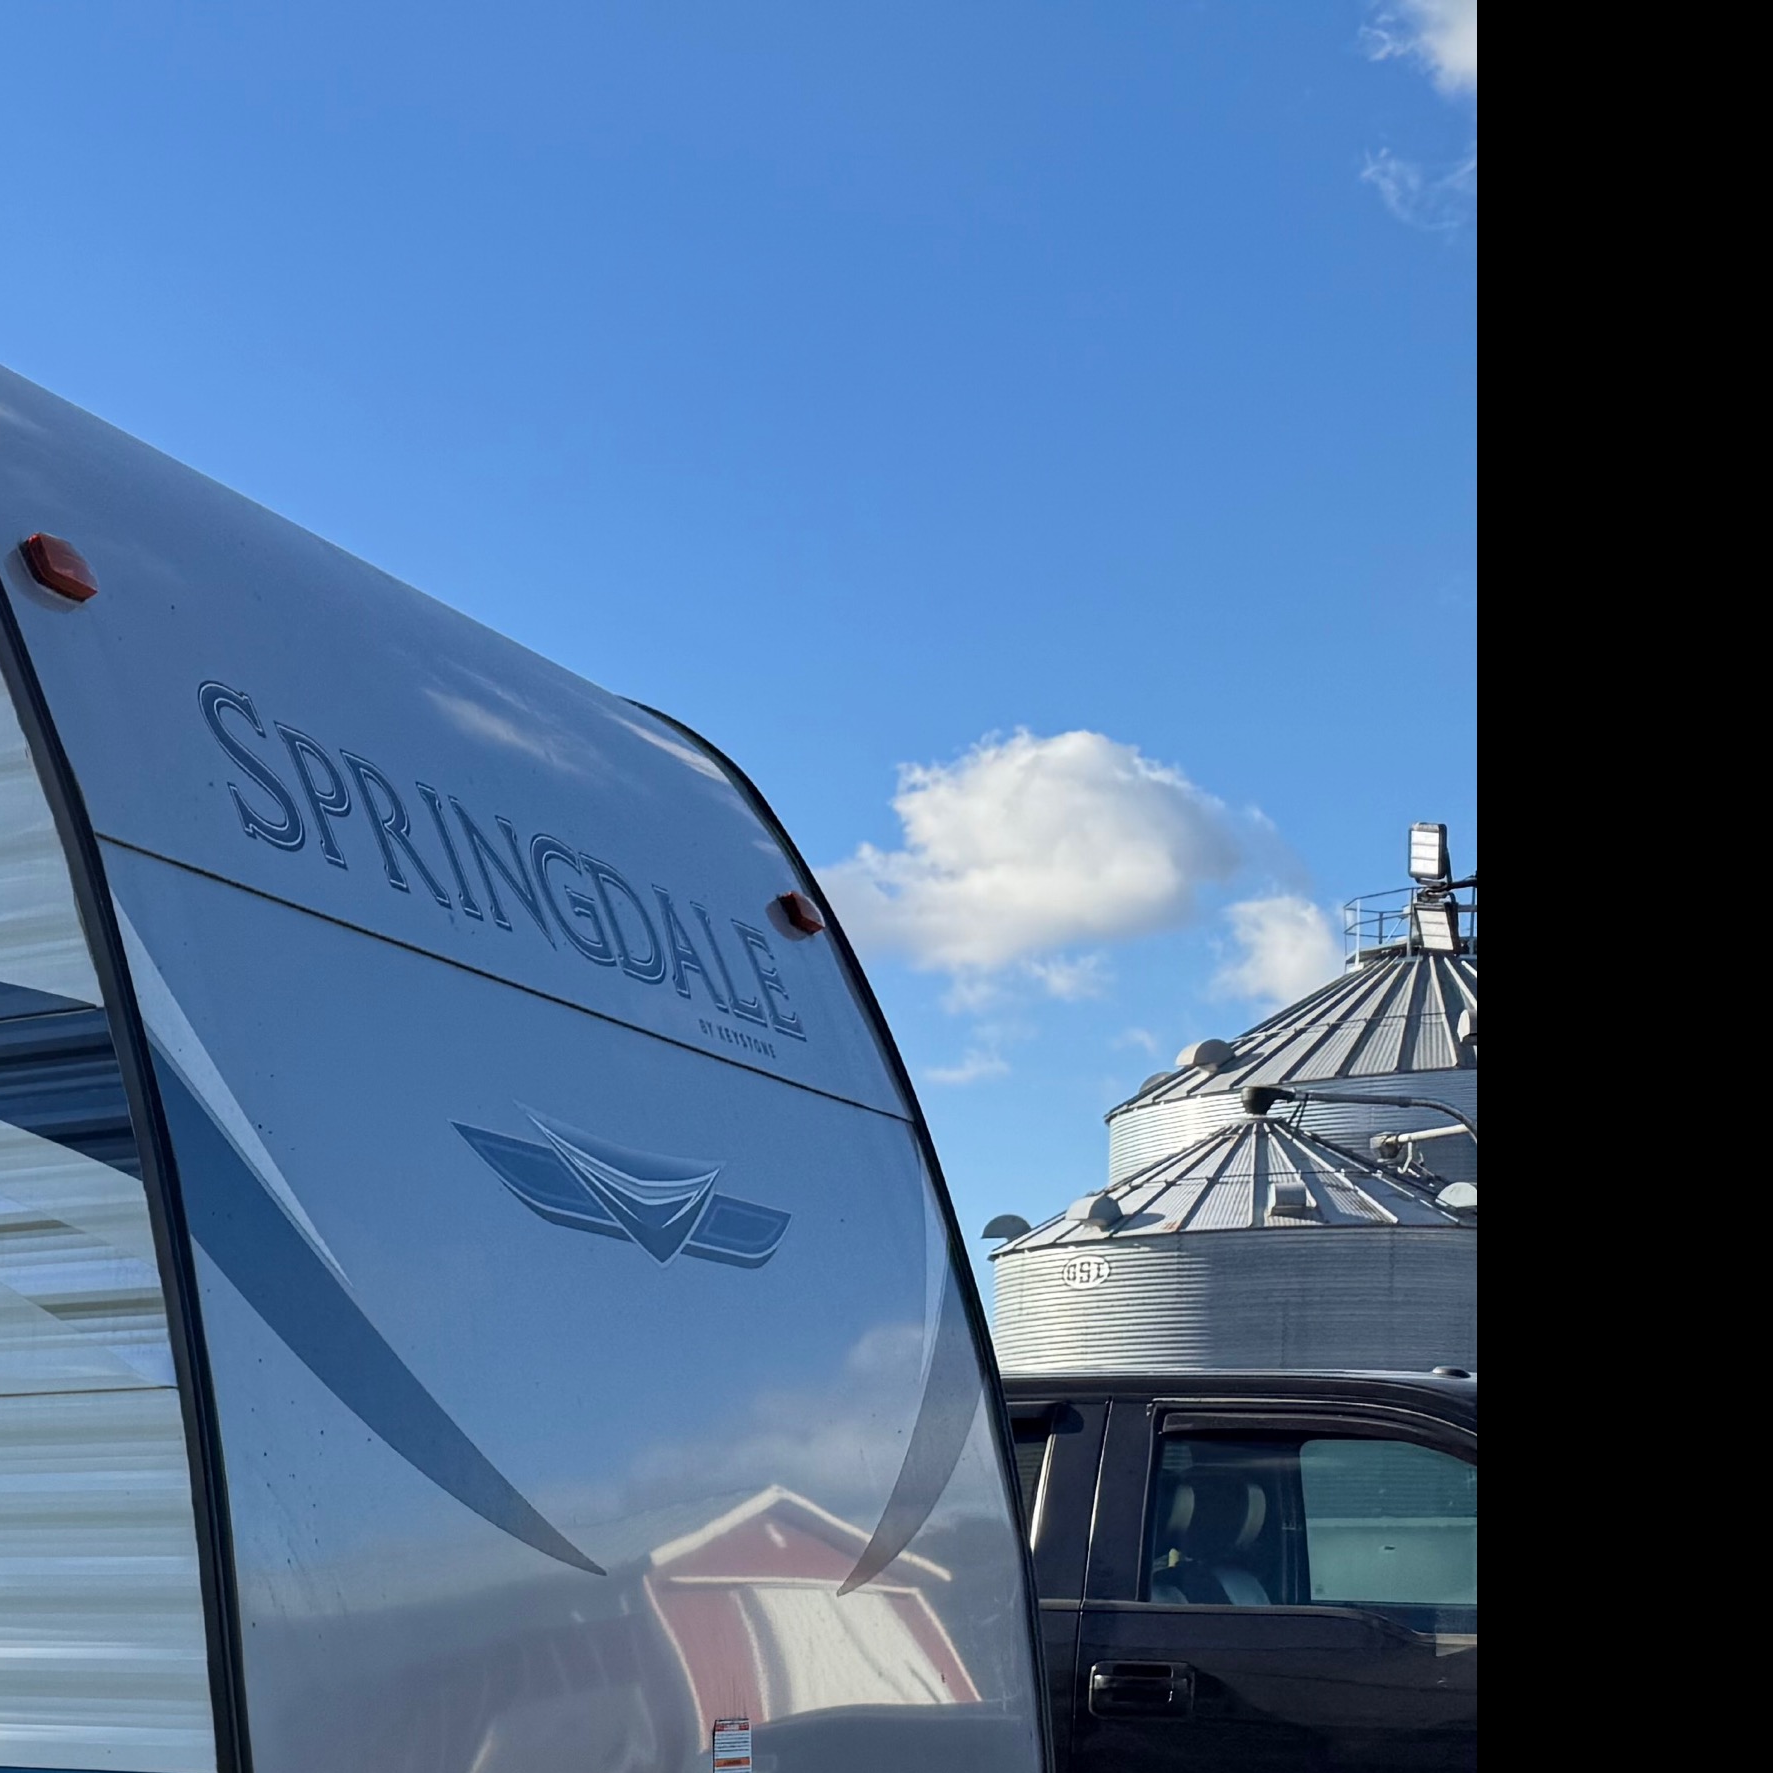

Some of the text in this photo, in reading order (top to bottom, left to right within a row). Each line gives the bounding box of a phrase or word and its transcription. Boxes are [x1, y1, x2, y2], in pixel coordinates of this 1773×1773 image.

[198, 680, 807, 1042] SPRINGDALE
[699, 1018, 776, 1058] BY KEYSTONE
